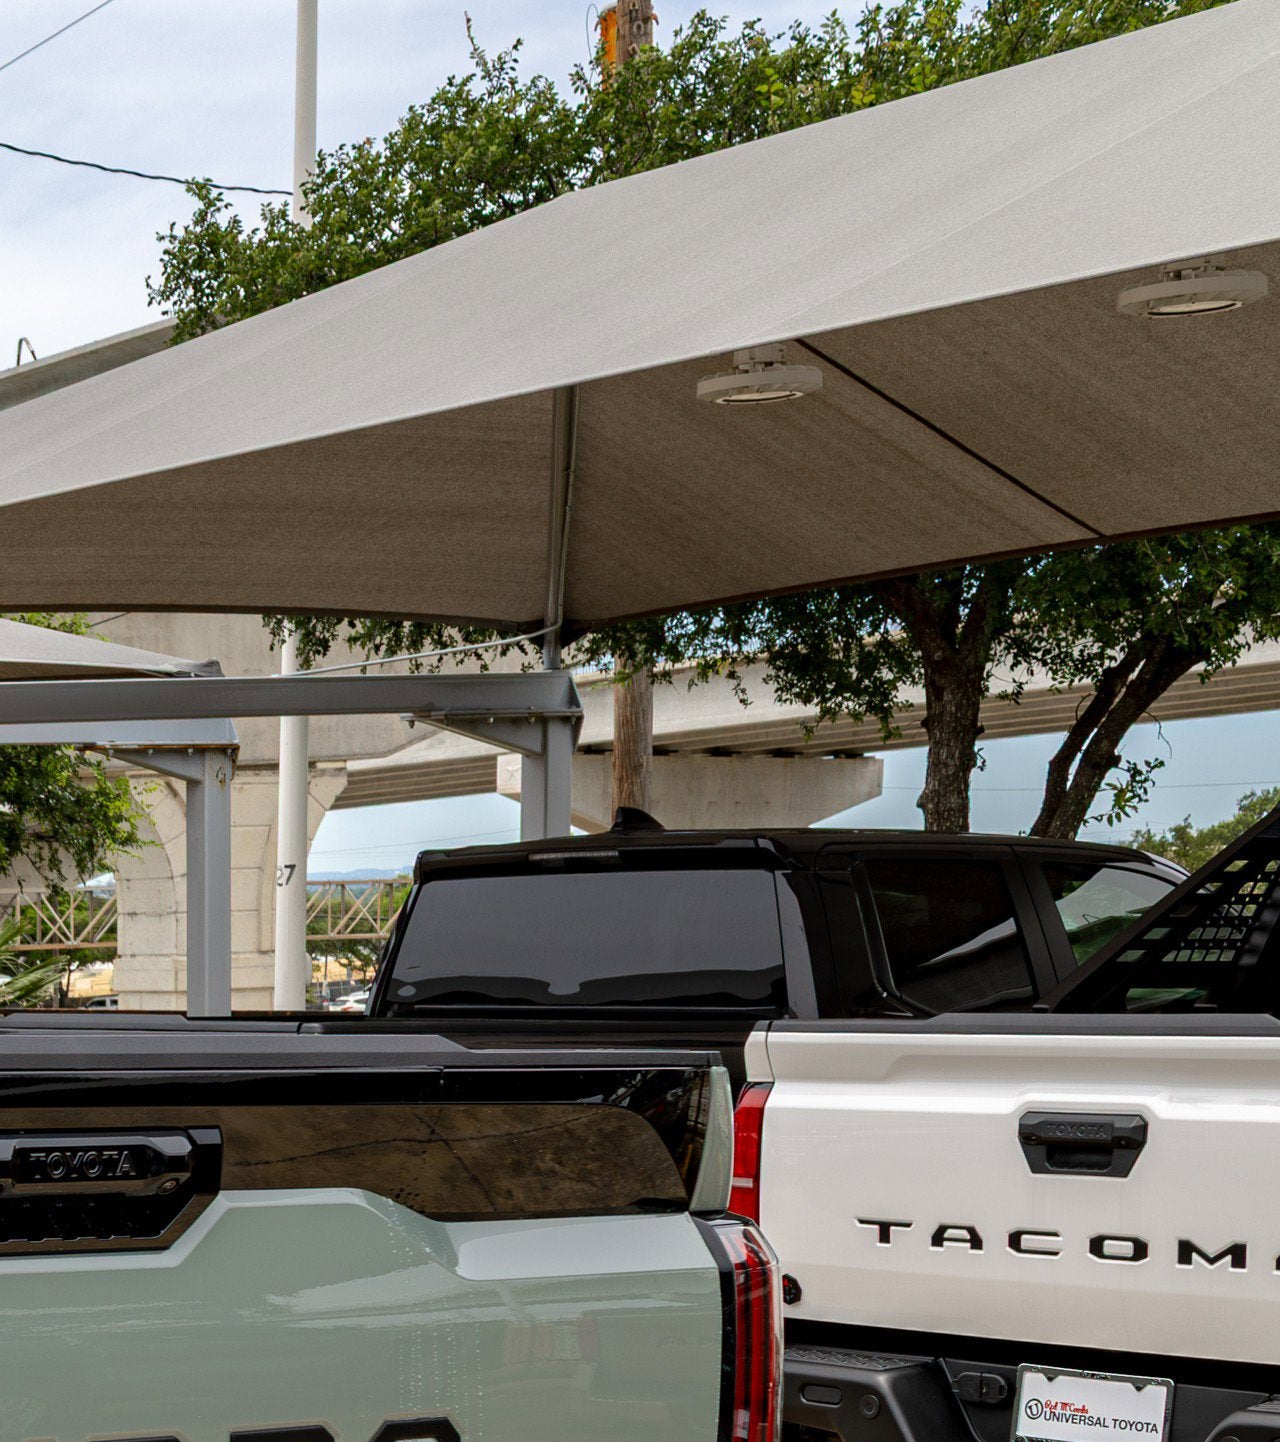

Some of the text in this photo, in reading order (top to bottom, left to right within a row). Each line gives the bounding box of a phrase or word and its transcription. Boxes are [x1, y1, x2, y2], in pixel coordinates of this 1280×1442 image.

[1046, 1124, 1107, 1138] TOYOTA
[29, 1151, 136, 1179] TOYOTA
[854, 1217, 1280, 1274] TACOM
[1044, 1410, 1159, 1435] UNIVERSAL TOYOTA
